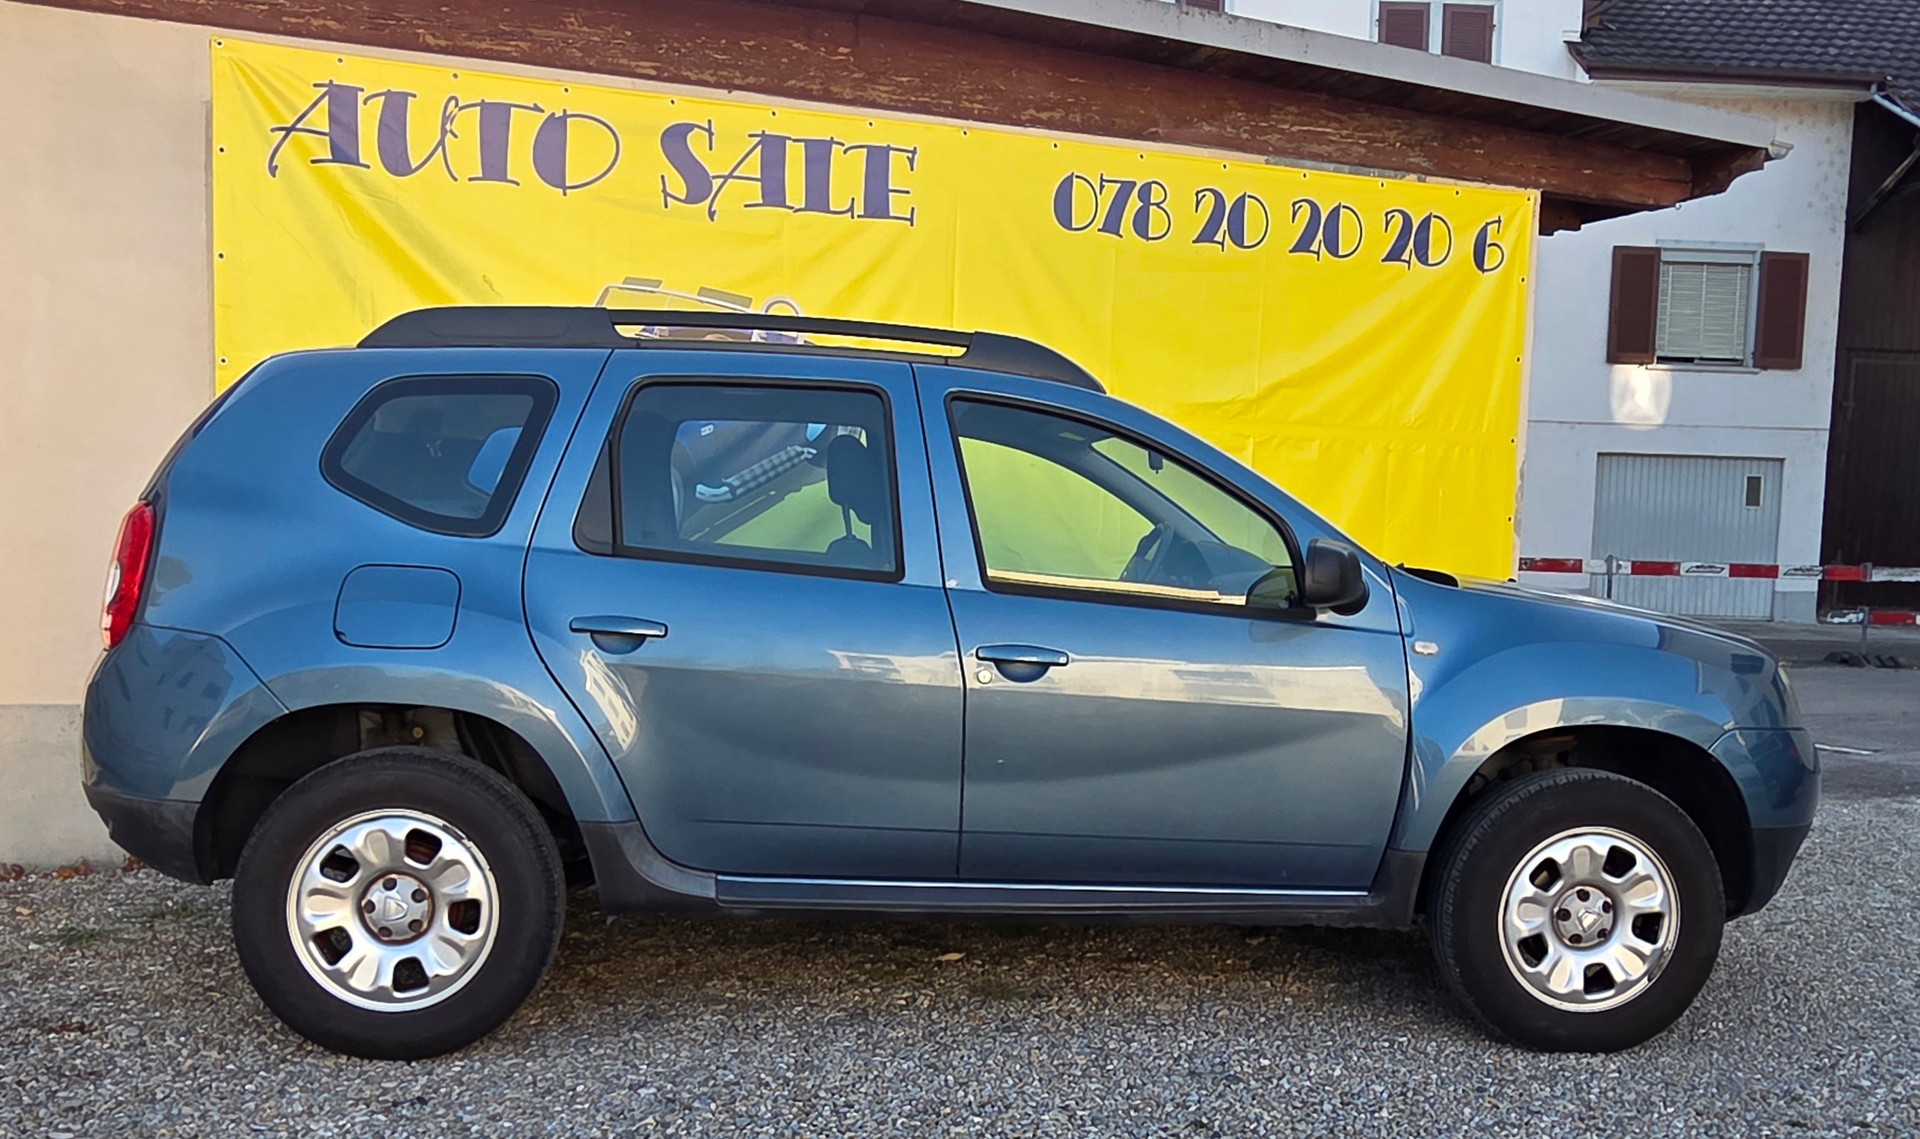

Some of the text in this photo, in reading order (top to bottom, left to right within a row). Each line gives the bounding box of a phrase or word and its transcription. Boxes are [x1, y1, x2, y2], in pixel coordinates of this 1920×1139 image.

[268, 80, 917, 227] AUTO SALE
[1053, 172, 1505, 274] 078 20 20 20 6
